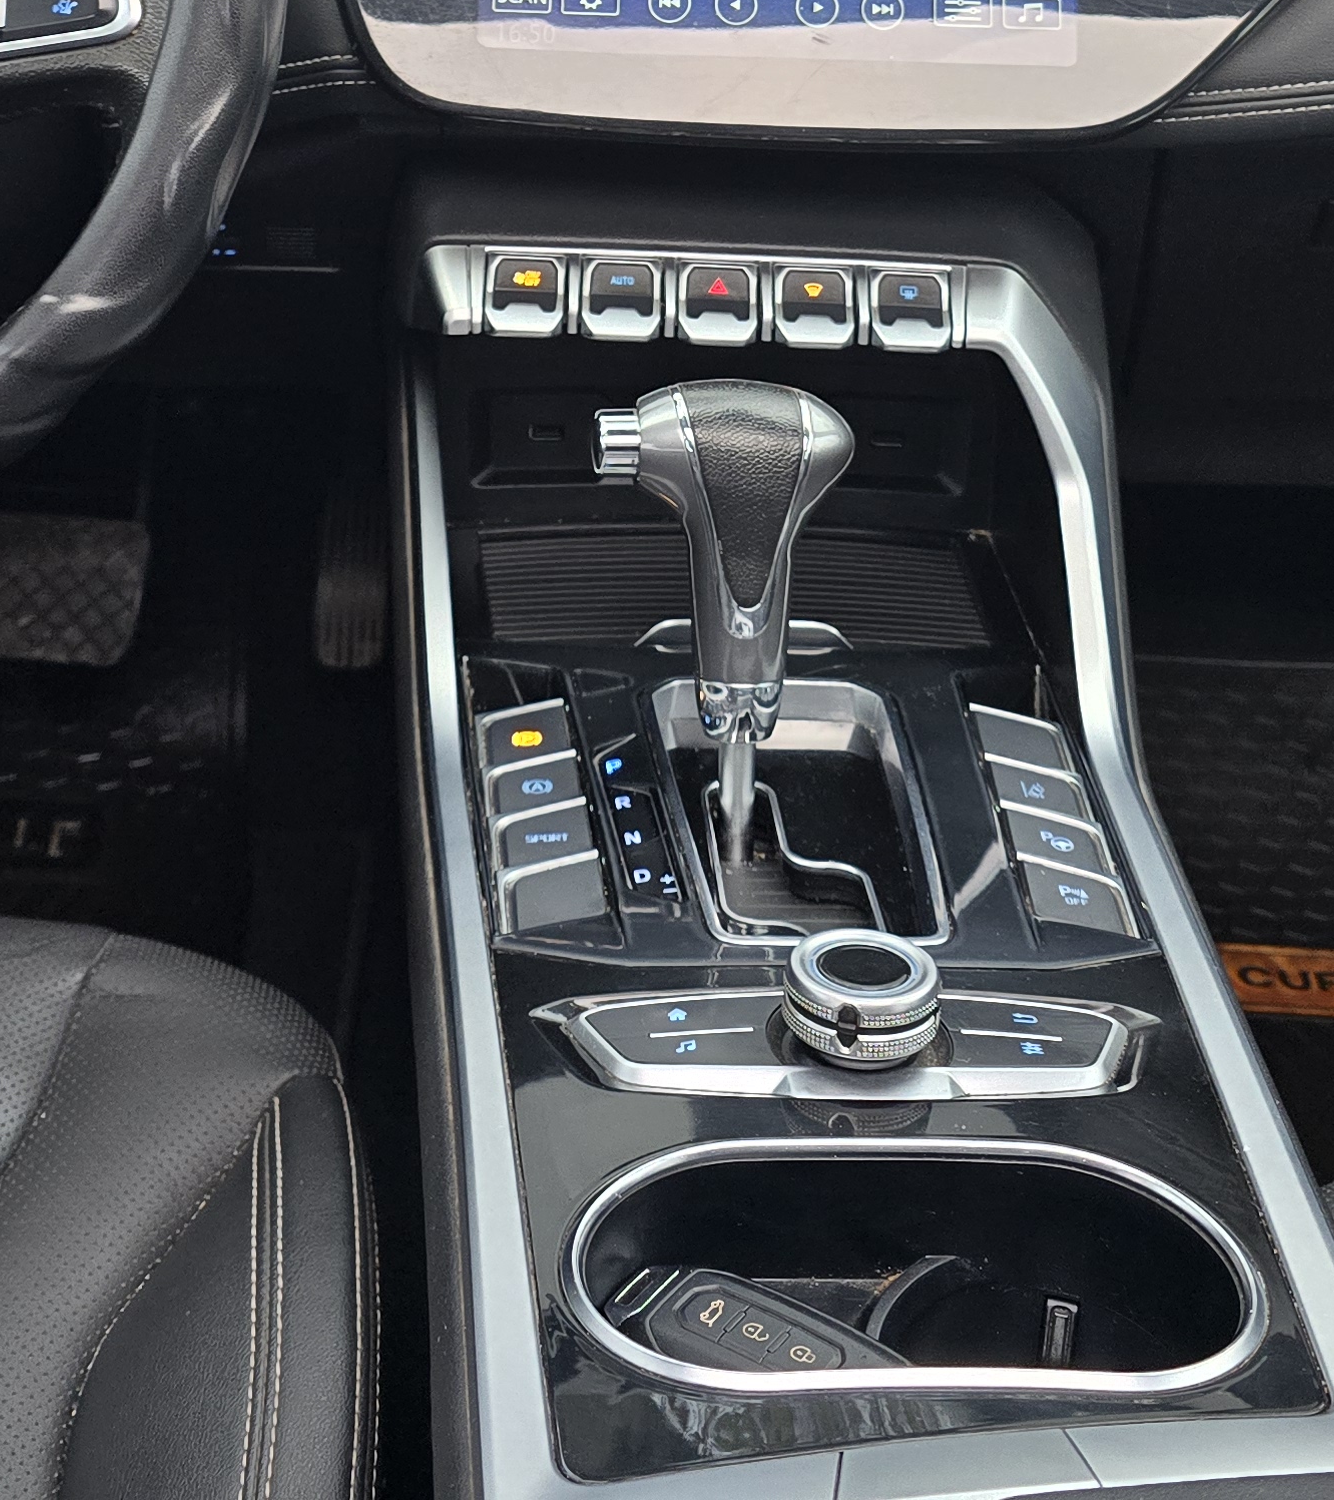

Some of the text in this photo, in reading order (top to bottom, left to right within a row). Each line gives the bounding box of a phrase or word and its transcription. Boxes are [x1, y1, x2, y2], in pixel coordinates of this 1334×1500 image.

[497, 23, 556, 44] 16:50
[610, 276, 636, 286] AUTO
[605, 758, 623, 775] P
[615, 795, 632, 810] R
[624, 831, 642, 845] N
[633, 868, 652, 884] D
